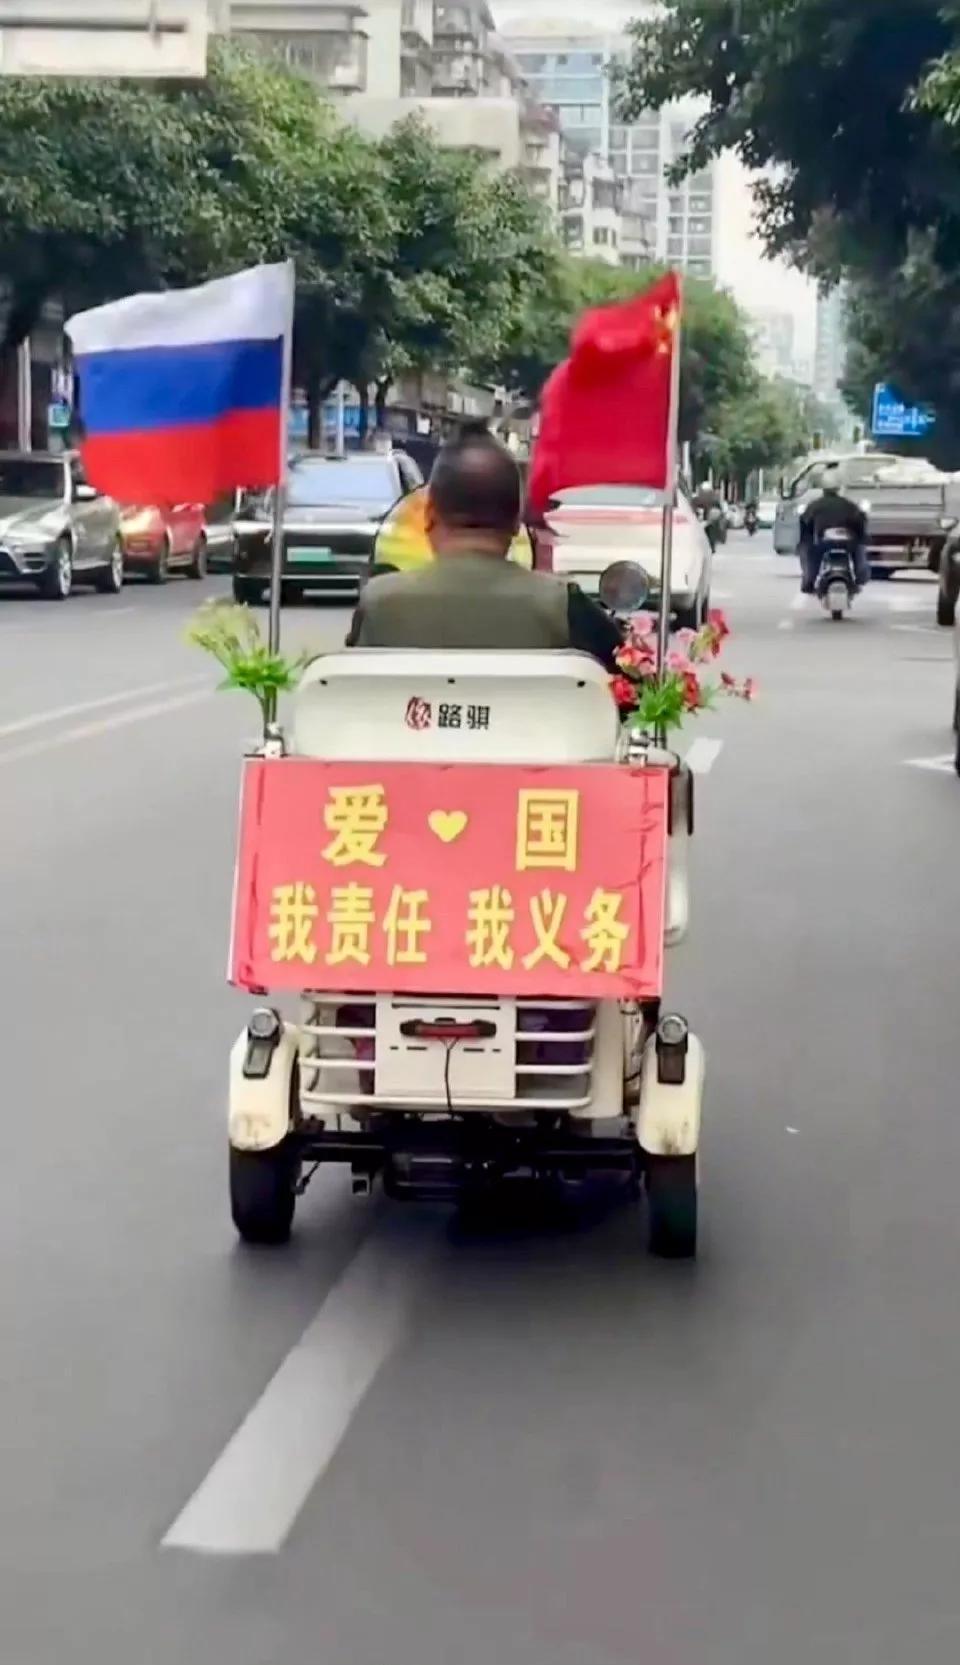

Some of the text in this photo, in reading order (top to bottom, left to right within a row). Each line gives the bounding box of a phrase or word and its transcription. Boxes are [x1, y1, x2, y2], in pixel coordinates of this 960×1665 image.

[322, 784, 580, 872] 爱 国
[268, 881, 631, 973] 我责任 我义务
